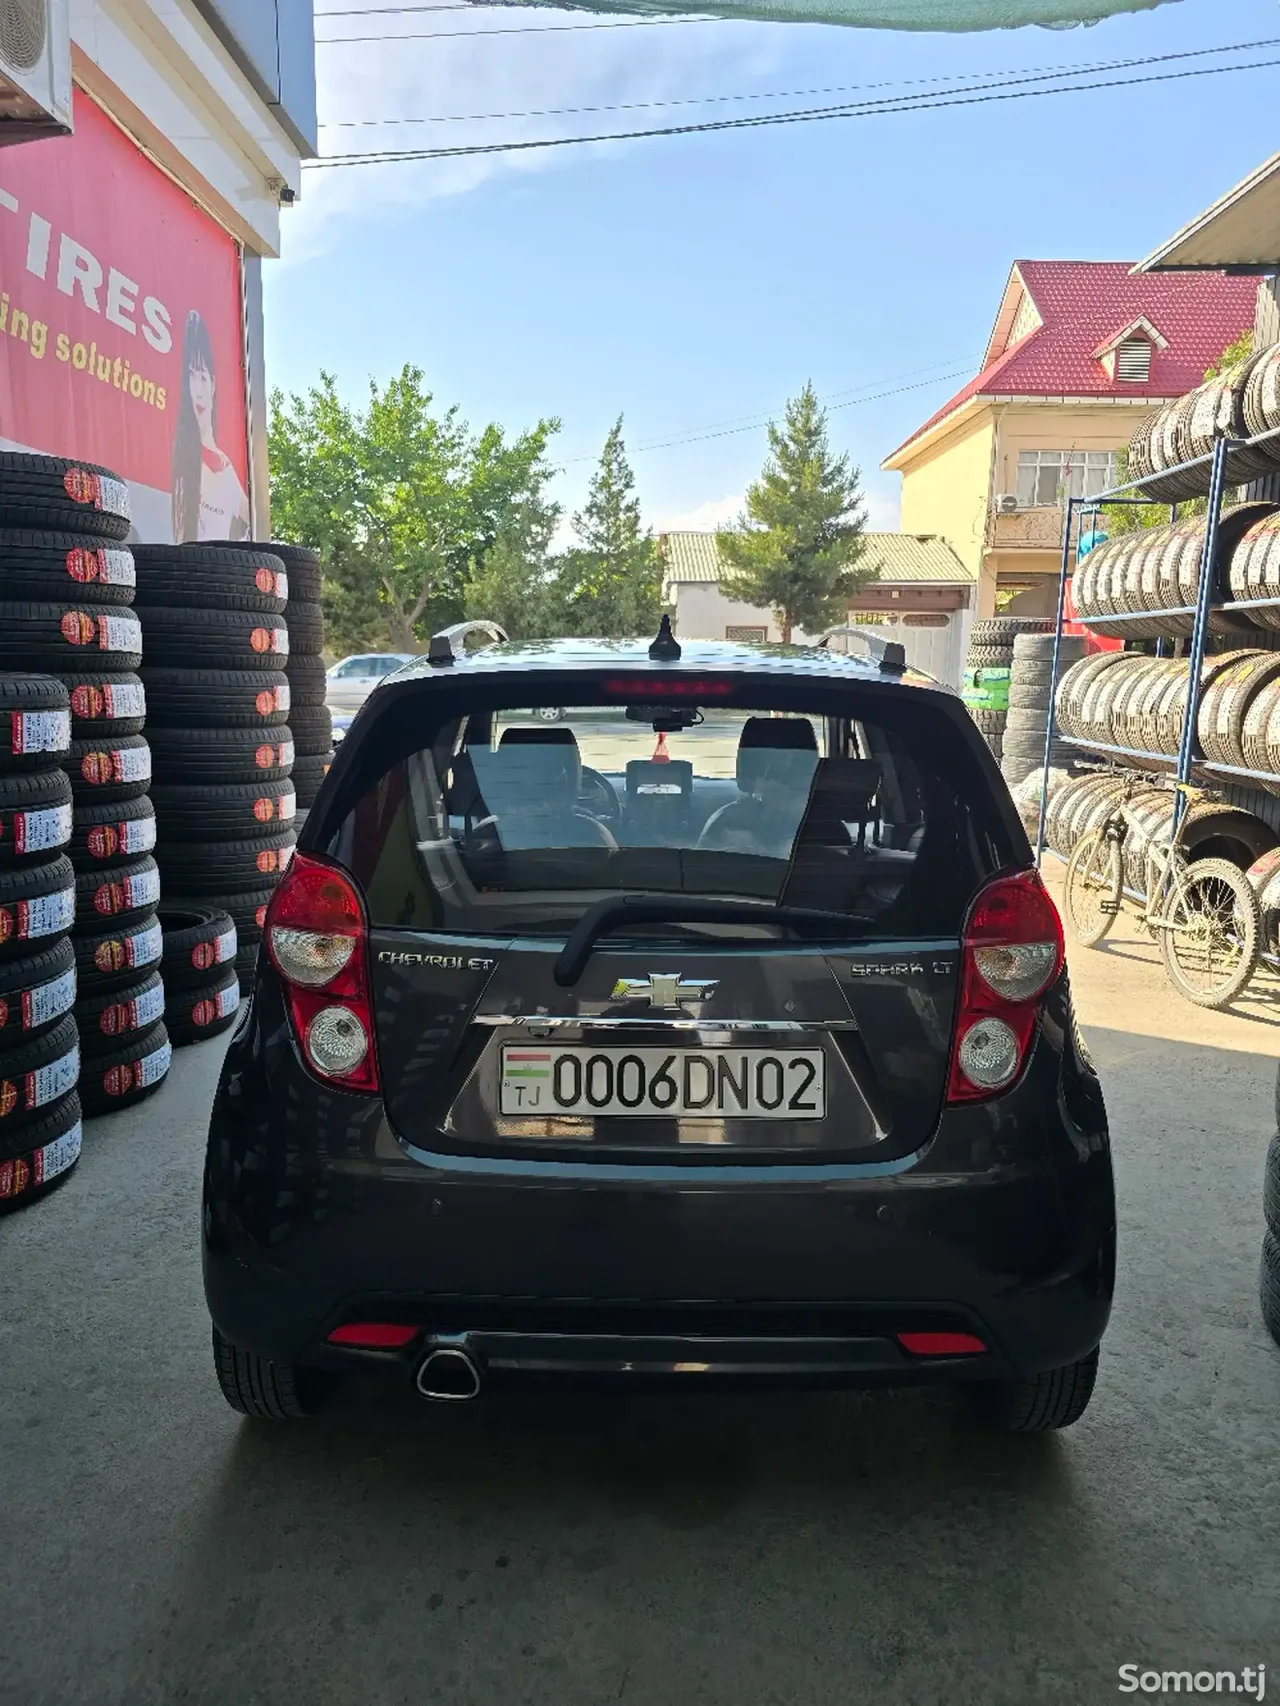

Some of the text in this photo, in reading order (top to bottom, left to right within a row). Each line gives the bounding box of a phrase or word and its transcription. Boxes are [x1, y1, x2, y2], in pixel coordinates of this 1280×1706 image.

[56, 333, 167, 410] solutions
[378, 951, 493, 970] CHEVROLET
[852, 961, 953, 976] SPARK LT
[514, 1053, 817, 1111] TJ 0006DN02
